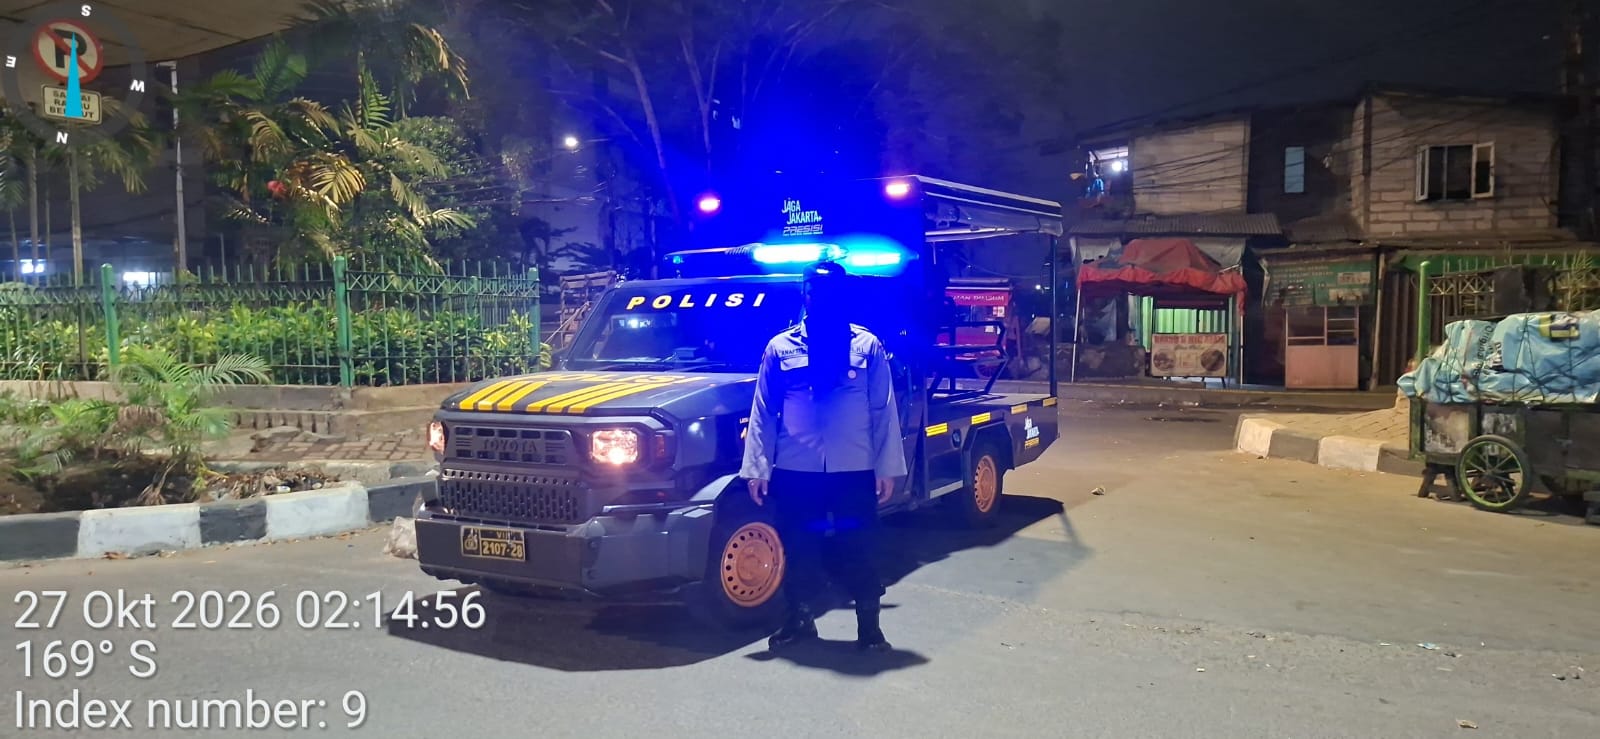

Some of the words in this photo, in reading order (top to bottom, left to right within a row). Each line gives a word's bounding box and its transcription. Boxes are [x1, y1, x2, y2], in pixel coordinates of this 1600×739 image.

[53, 99, 90, 110] RAU
[781, 199, 801, 214] JAGA
[626, 293, 766, 310] POLISI
[483, 440, 537, 453] TOYOTA
